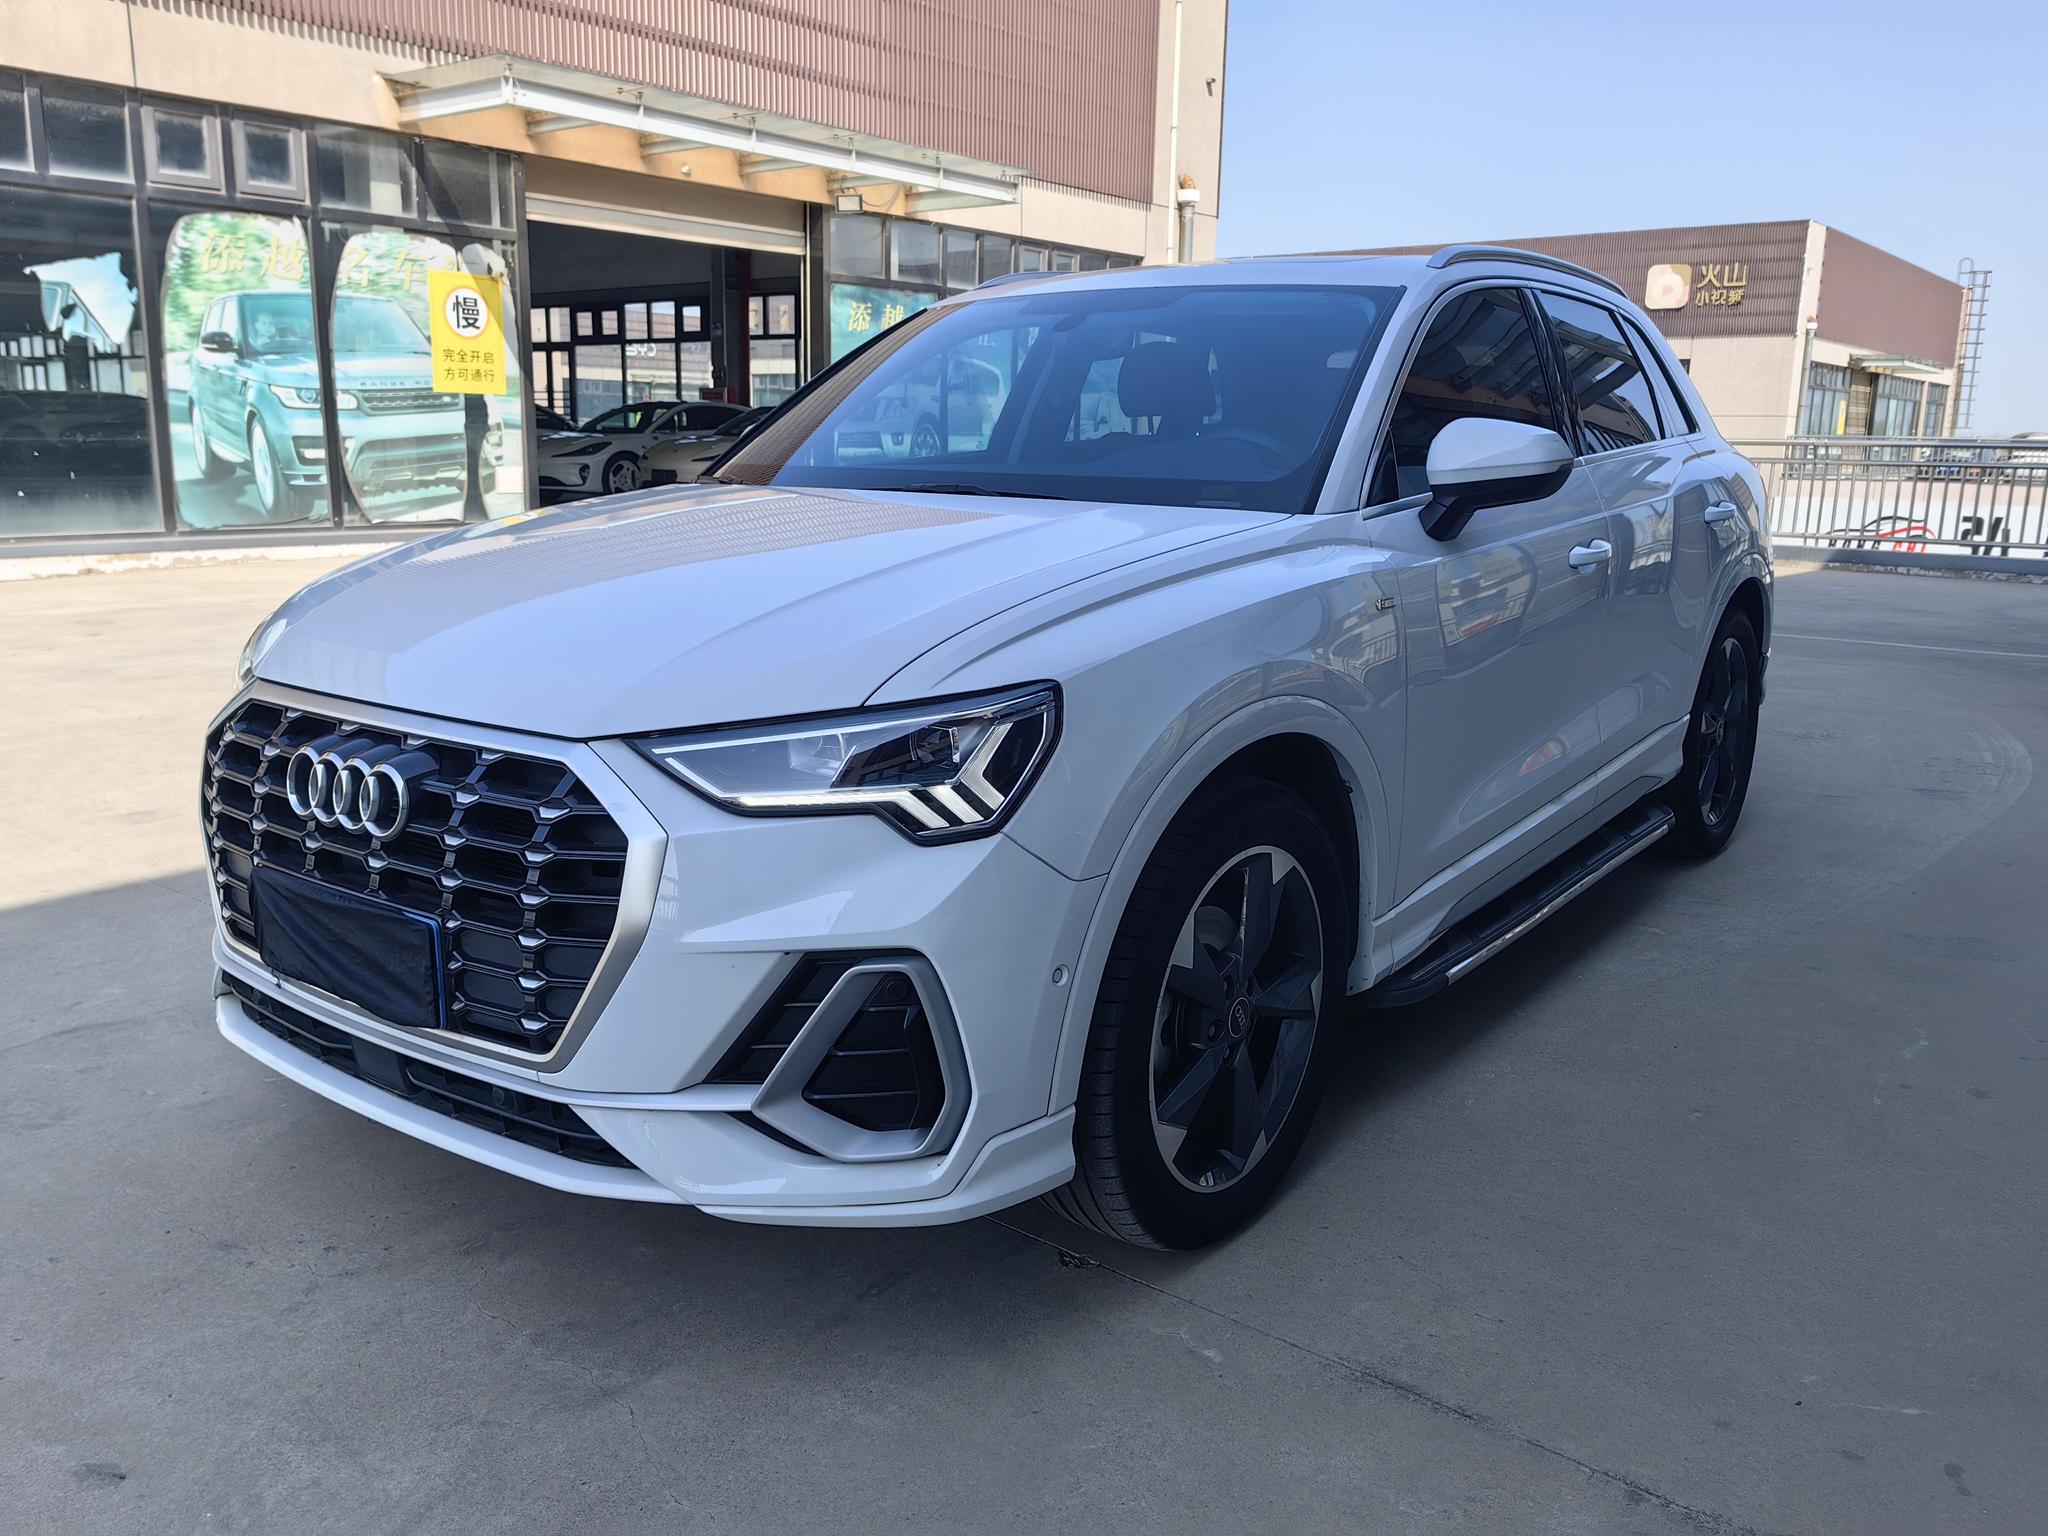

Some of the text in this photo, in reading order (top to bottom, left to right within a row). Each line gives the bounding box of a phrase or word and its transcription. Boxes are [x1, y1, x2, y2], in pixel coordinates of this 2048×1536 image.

[1696, 262, 1748, 288] 火山
[1695, 288, 1745, 306] 小视频
[452, 294, 481, 330] 慢
[443, 348, 494, 364] 完全开启
[444, 367, 495, 383] 方可通行
